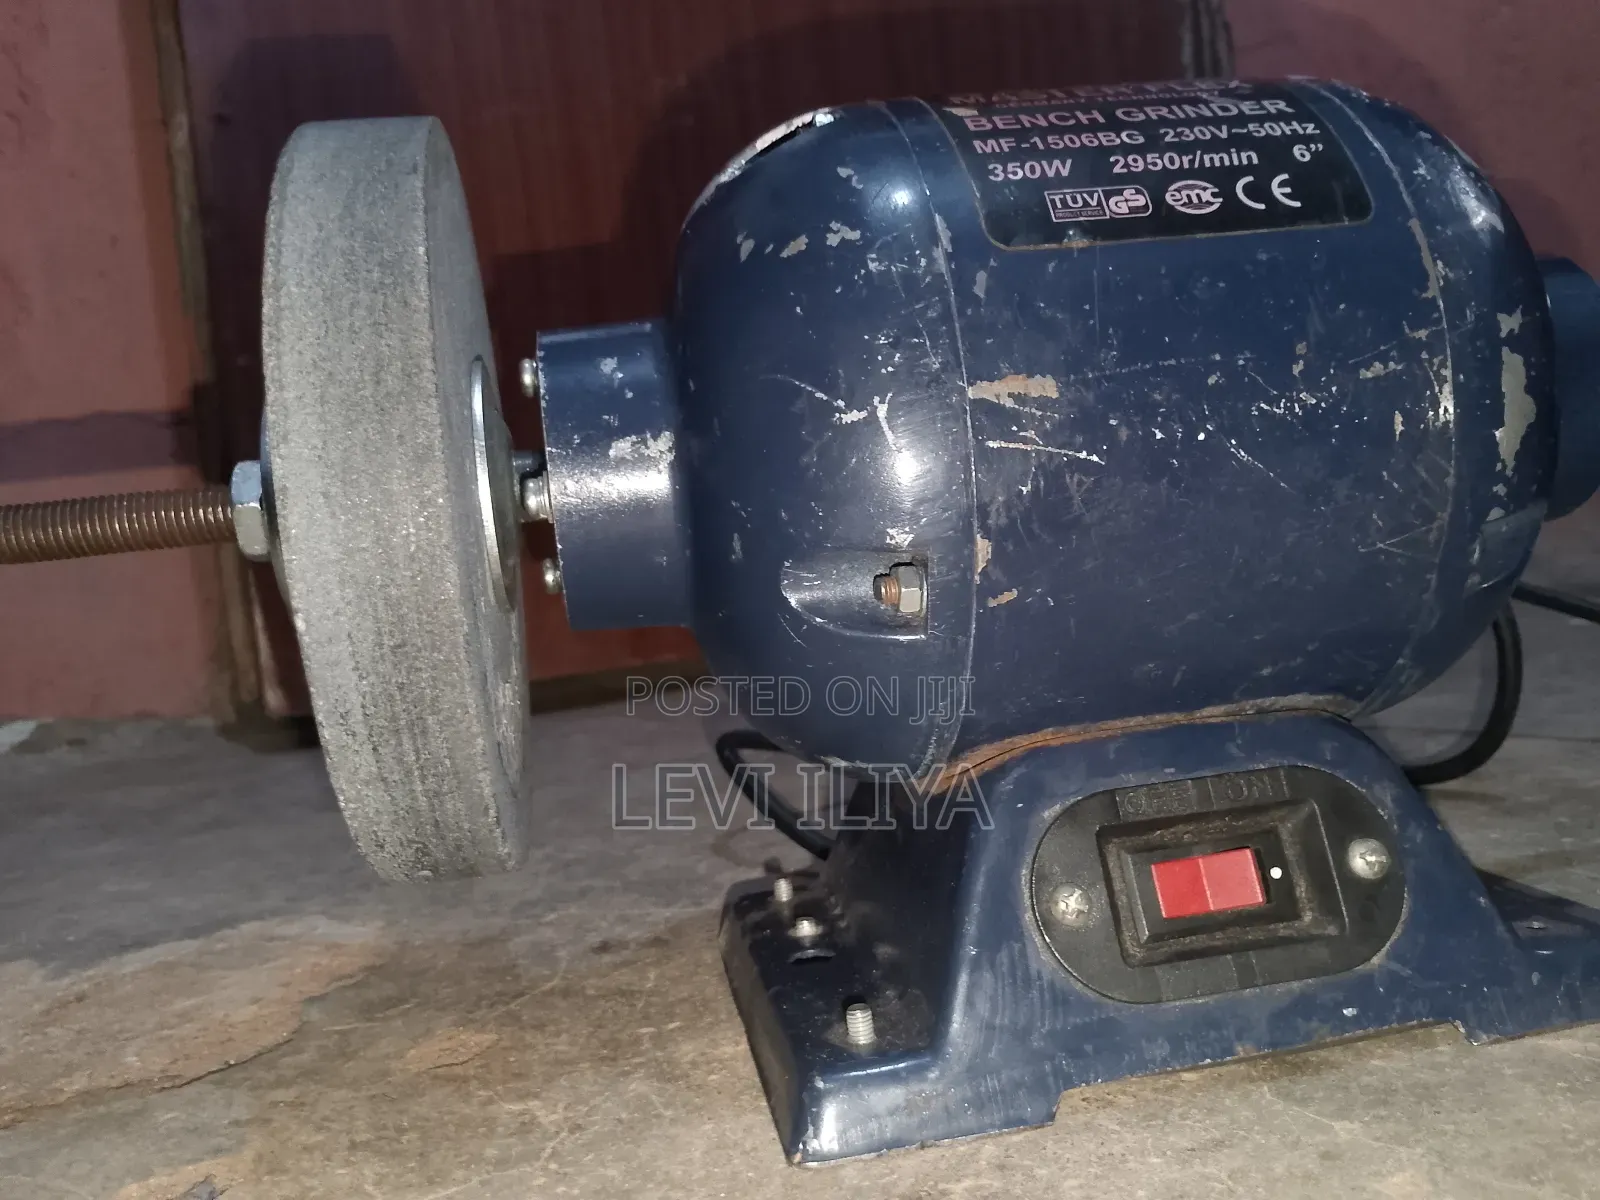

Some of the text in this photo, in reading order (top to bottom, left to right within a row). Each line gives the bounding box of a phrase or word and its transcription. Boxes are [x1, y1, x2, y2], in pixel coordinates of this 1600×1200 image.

[963, 99, 1296, 132] BENCH GRINDER
[972, 120, 1321, 154] MF-1506BG 230V~50Hz
[987, 158, 1073, 182] 350W
[1109, 148, 1260, 174] 2950r/min
[1049, 192, 1099, 209] TÜV
[1108, 188, 1147, 214] GS
